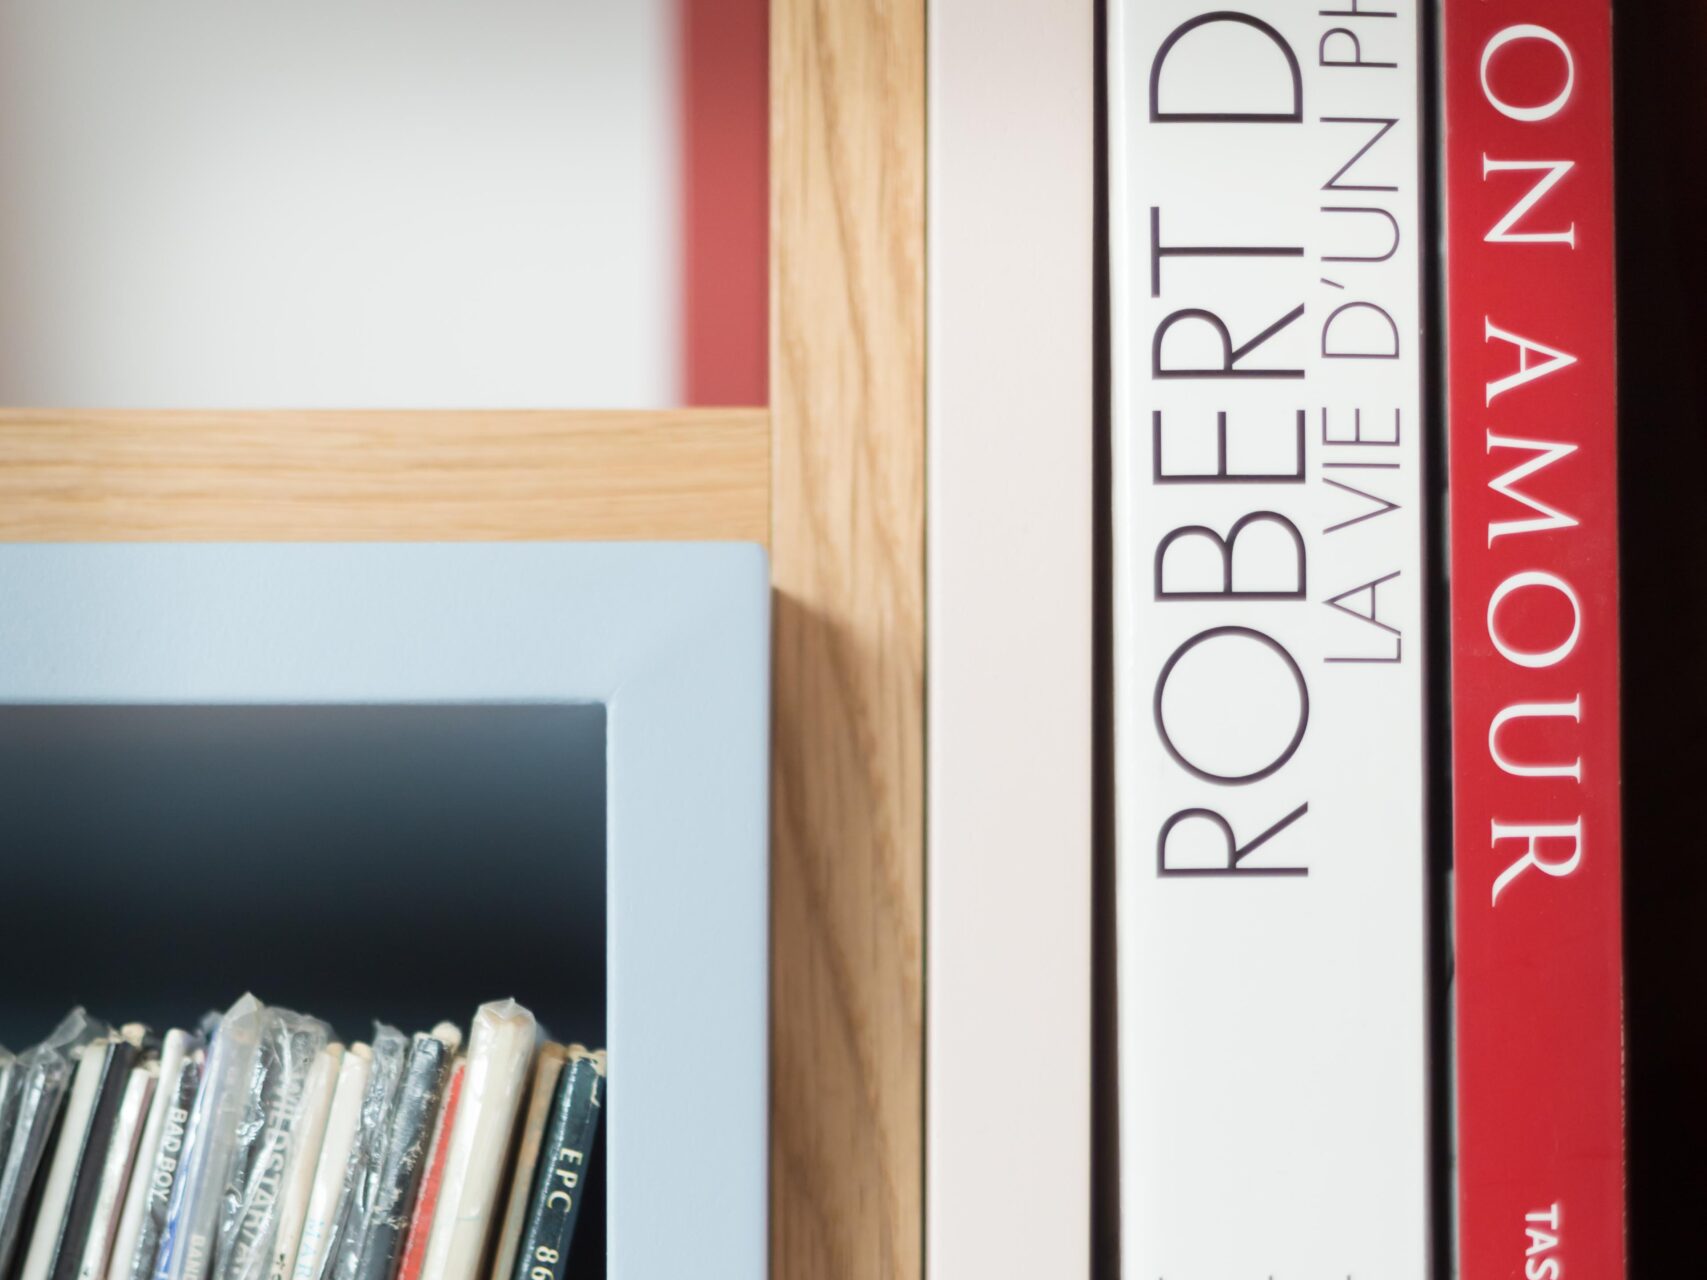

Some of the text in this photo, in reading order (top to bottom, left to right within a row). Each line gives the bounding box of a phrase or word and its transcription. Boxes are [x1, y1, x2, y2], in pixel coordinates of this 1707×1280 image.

[1319, 116, 1402, 361] D'UN
[1149, 10, 1310, 880] ROBERT D
[1321, 406, 1401, 535] VIE
[1477, 22, 1587, 905] ON AMOUR
[1321, 571, 1403, 665] LA
[151, 1107, 189, 1202] BAD BOY
[546, 1147, 584, 1214] EPC
